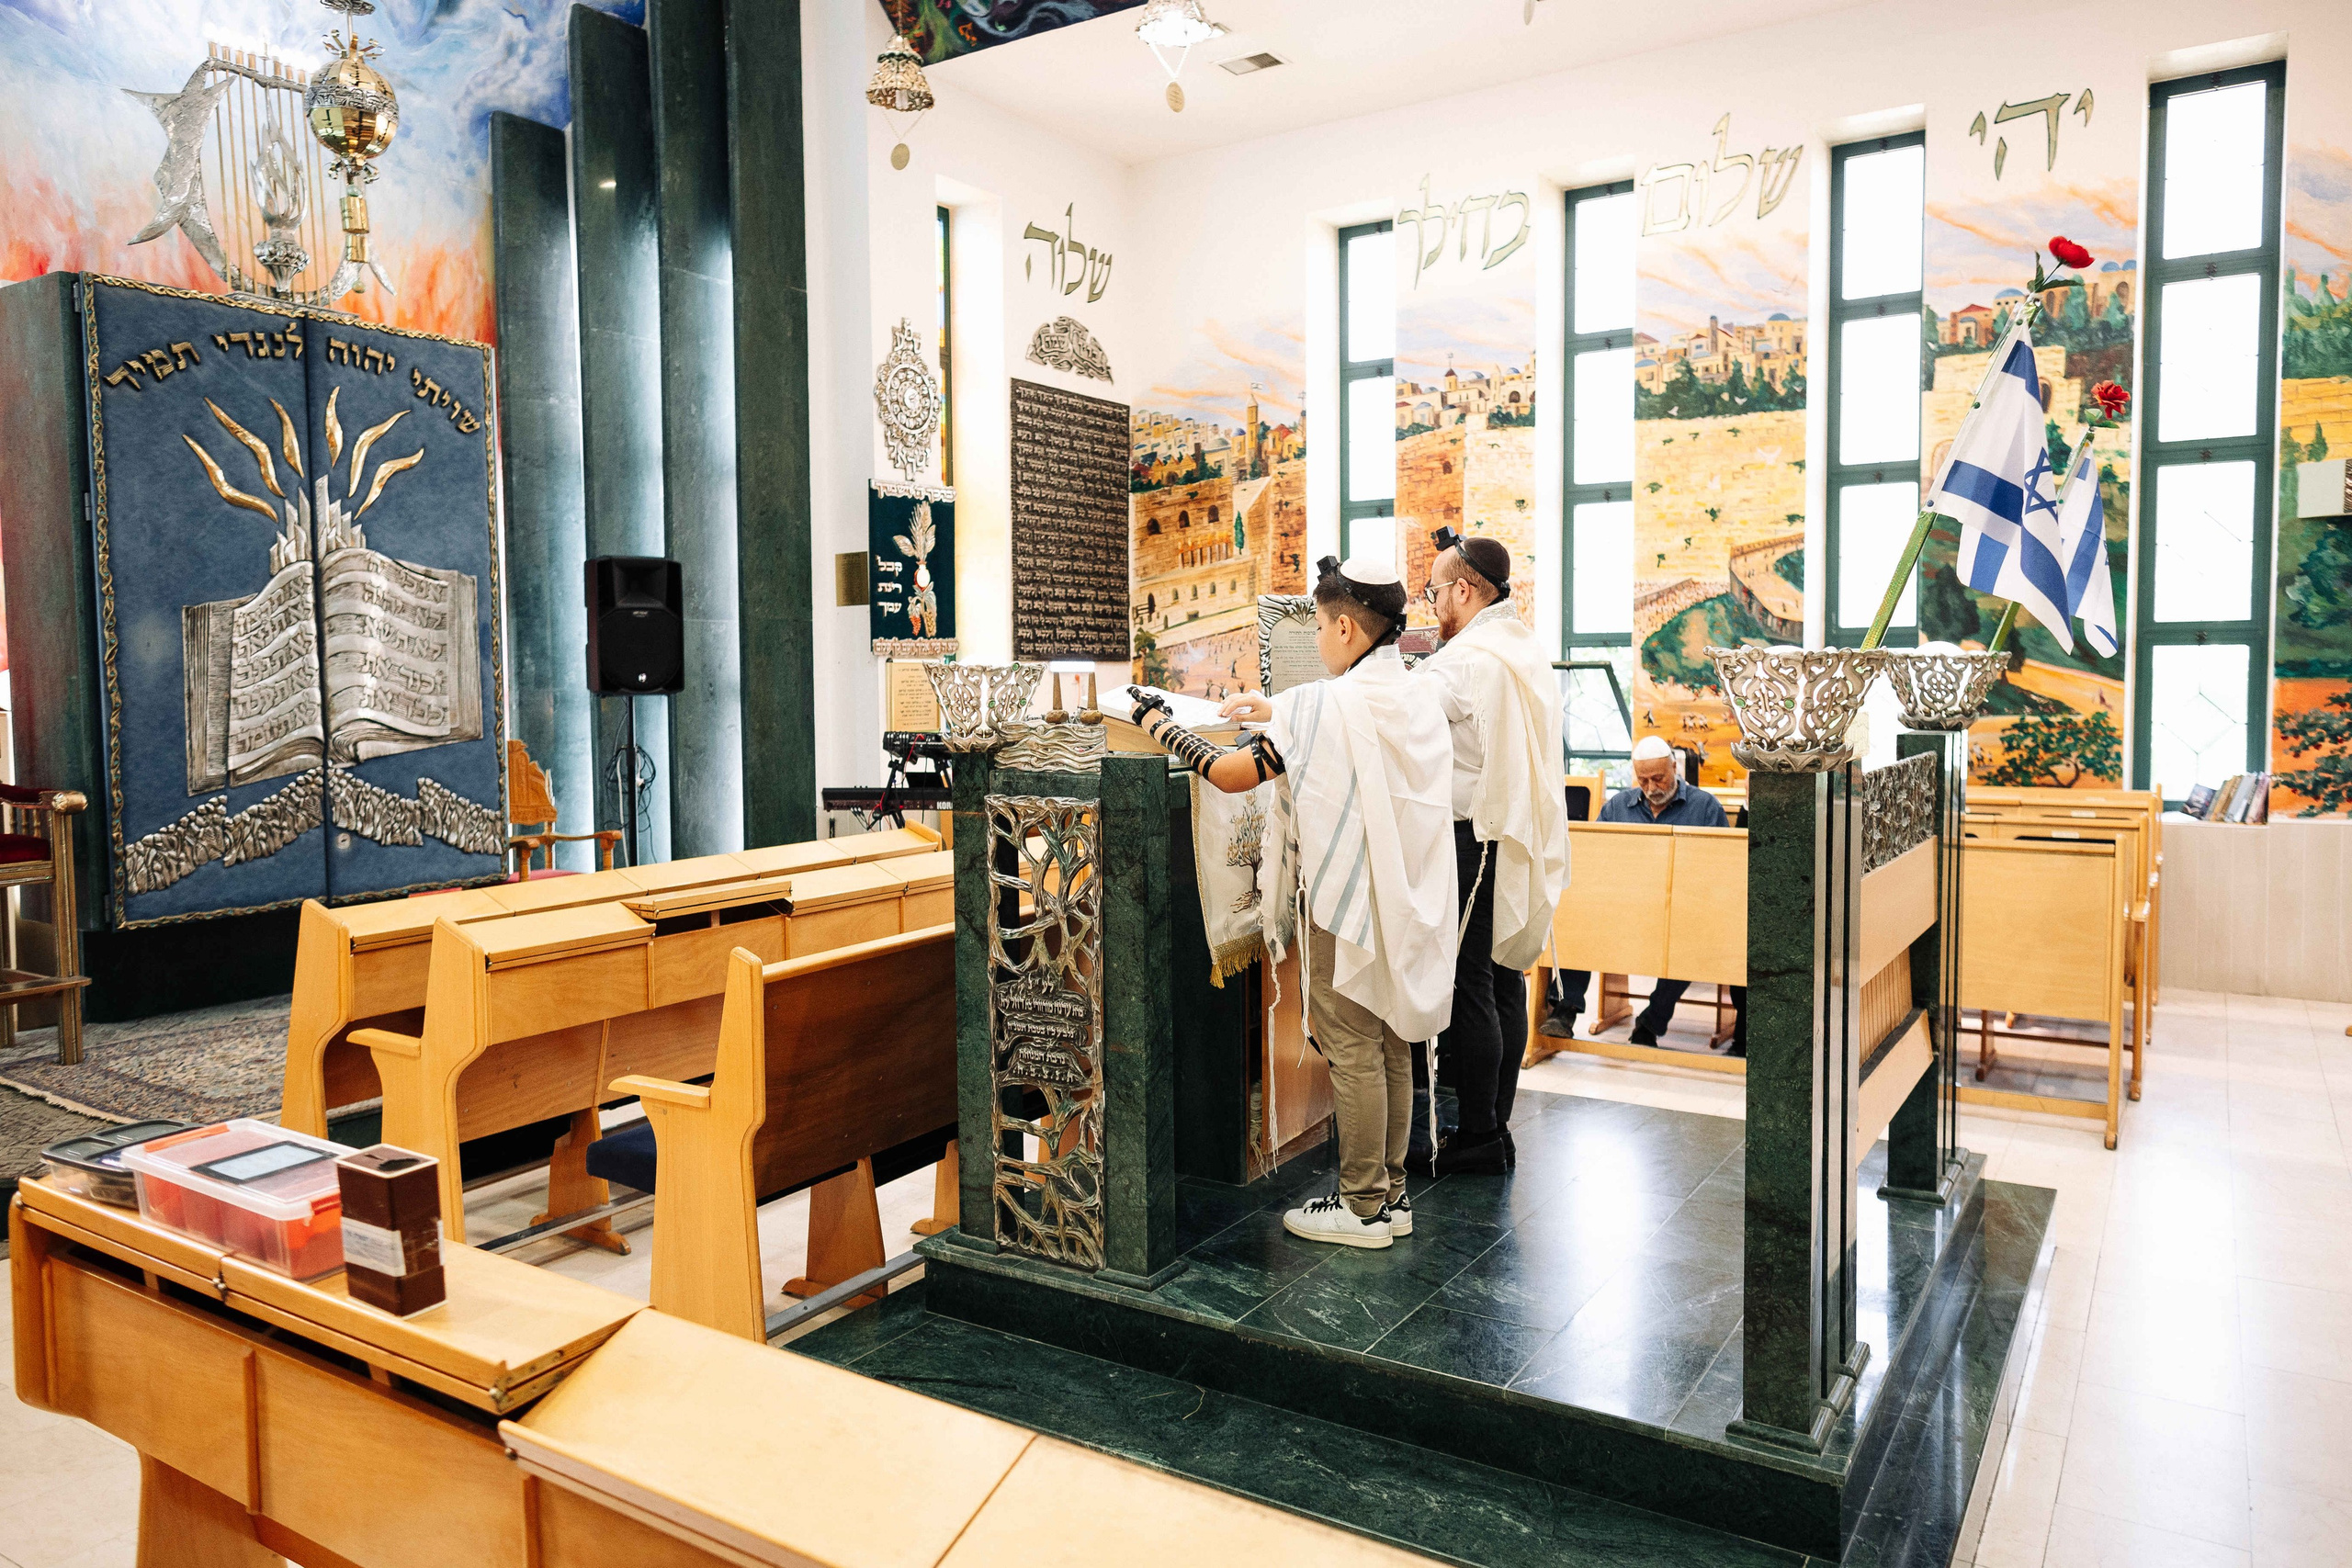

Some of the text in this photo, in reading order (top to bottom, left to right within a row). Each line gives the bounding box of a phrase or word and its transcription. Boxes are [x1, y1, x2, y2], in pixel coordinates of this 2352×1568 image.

[1969, 87, 2095, 181] יהי
[1640, 111, 1804, 238] שלום
[1023, 202, 1113, 303] שלוה
[104, 321, 481, 434] שויתי יהוה לנגדי תמיד
[399, 568, 442, 604] אנכי
[876, 555, 903, 577] קבל
[876, 601, 902, 617] עמך
[362, 613, 444, 661] לא תשא
[360, 653, 393, 682] את
[360, 687, 446, 727] כבד את
[936, 801, 953, 810] KOR
